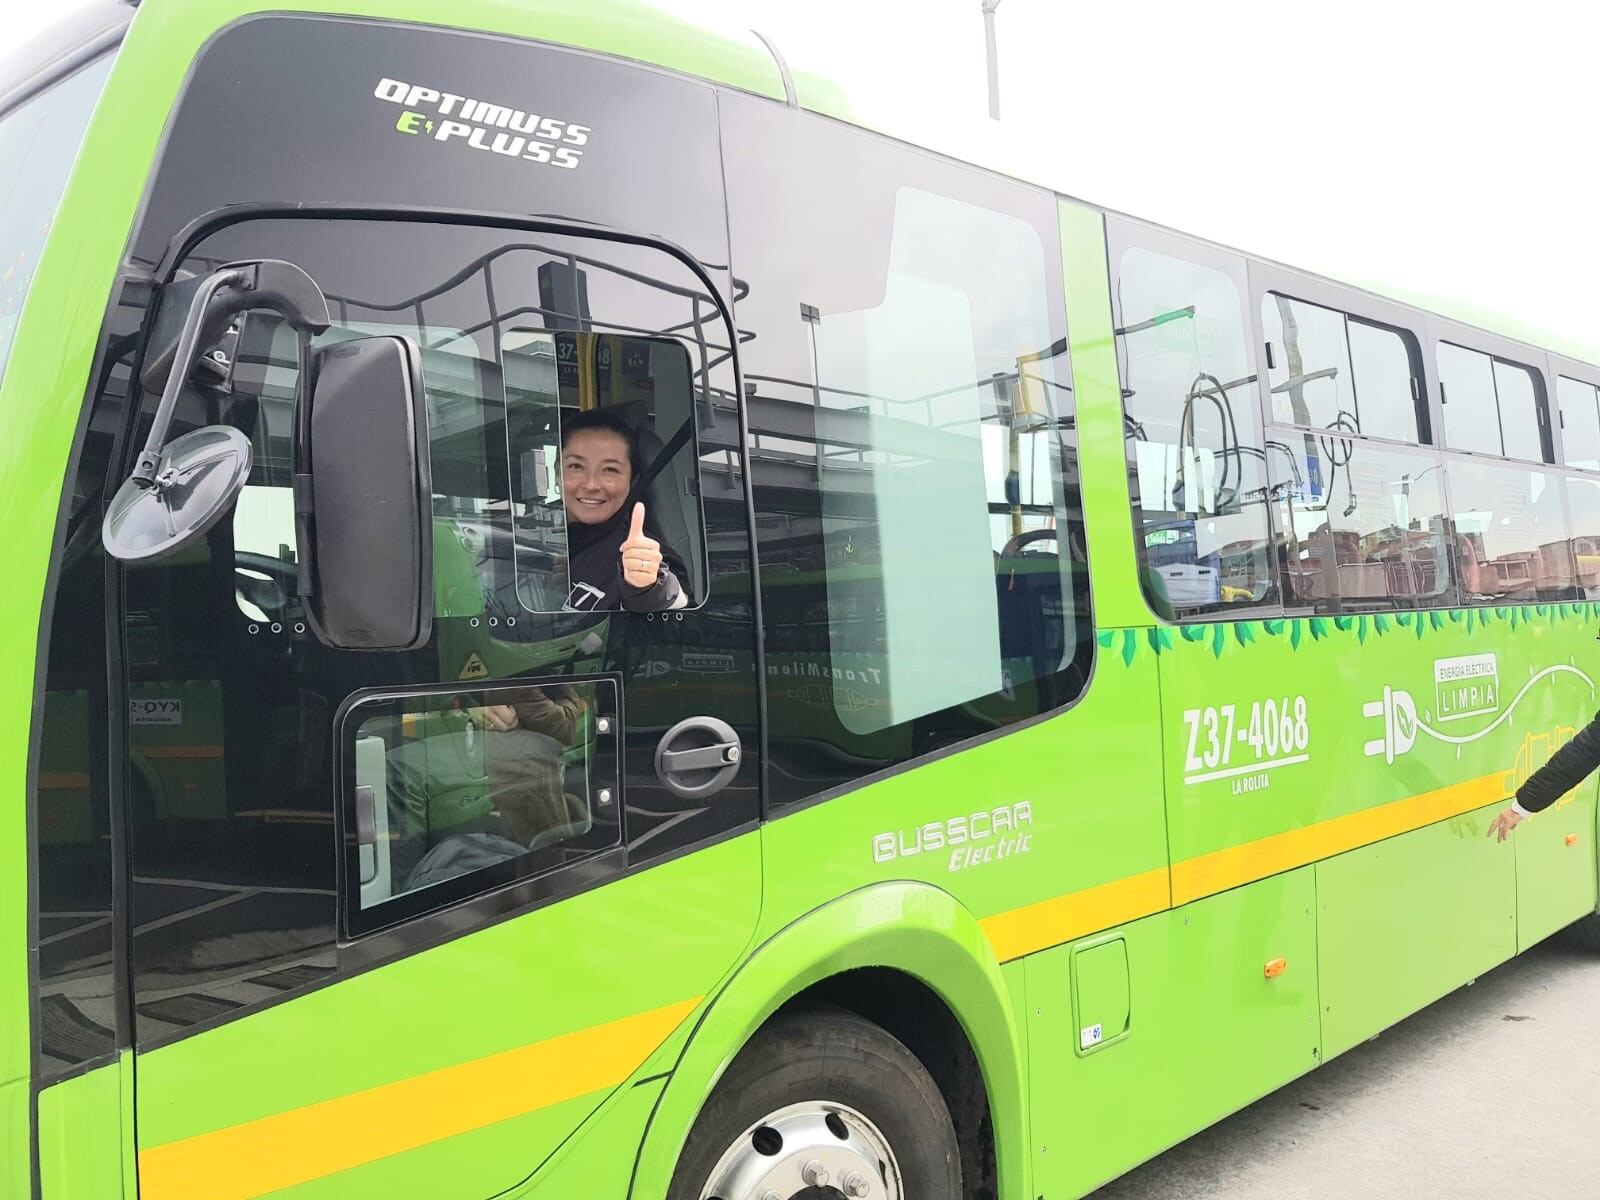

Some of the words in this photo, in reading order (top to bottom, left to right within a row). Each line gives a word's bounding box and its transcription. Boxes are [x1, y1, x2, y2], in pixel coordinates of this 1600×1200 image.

[374, 77, 592, 146] OPTIMUSS
[1442, 684, 1495, 713] LIMPIA
[1183, 695, 1310, 772] Z37-4068
[1231, 779, 1243, 795] LA
[1243, 773, 1270, 793] ROLITA
[872, 800, 1033, 864] BUSSCAR
[947, 832, 1033, 873] Electric
